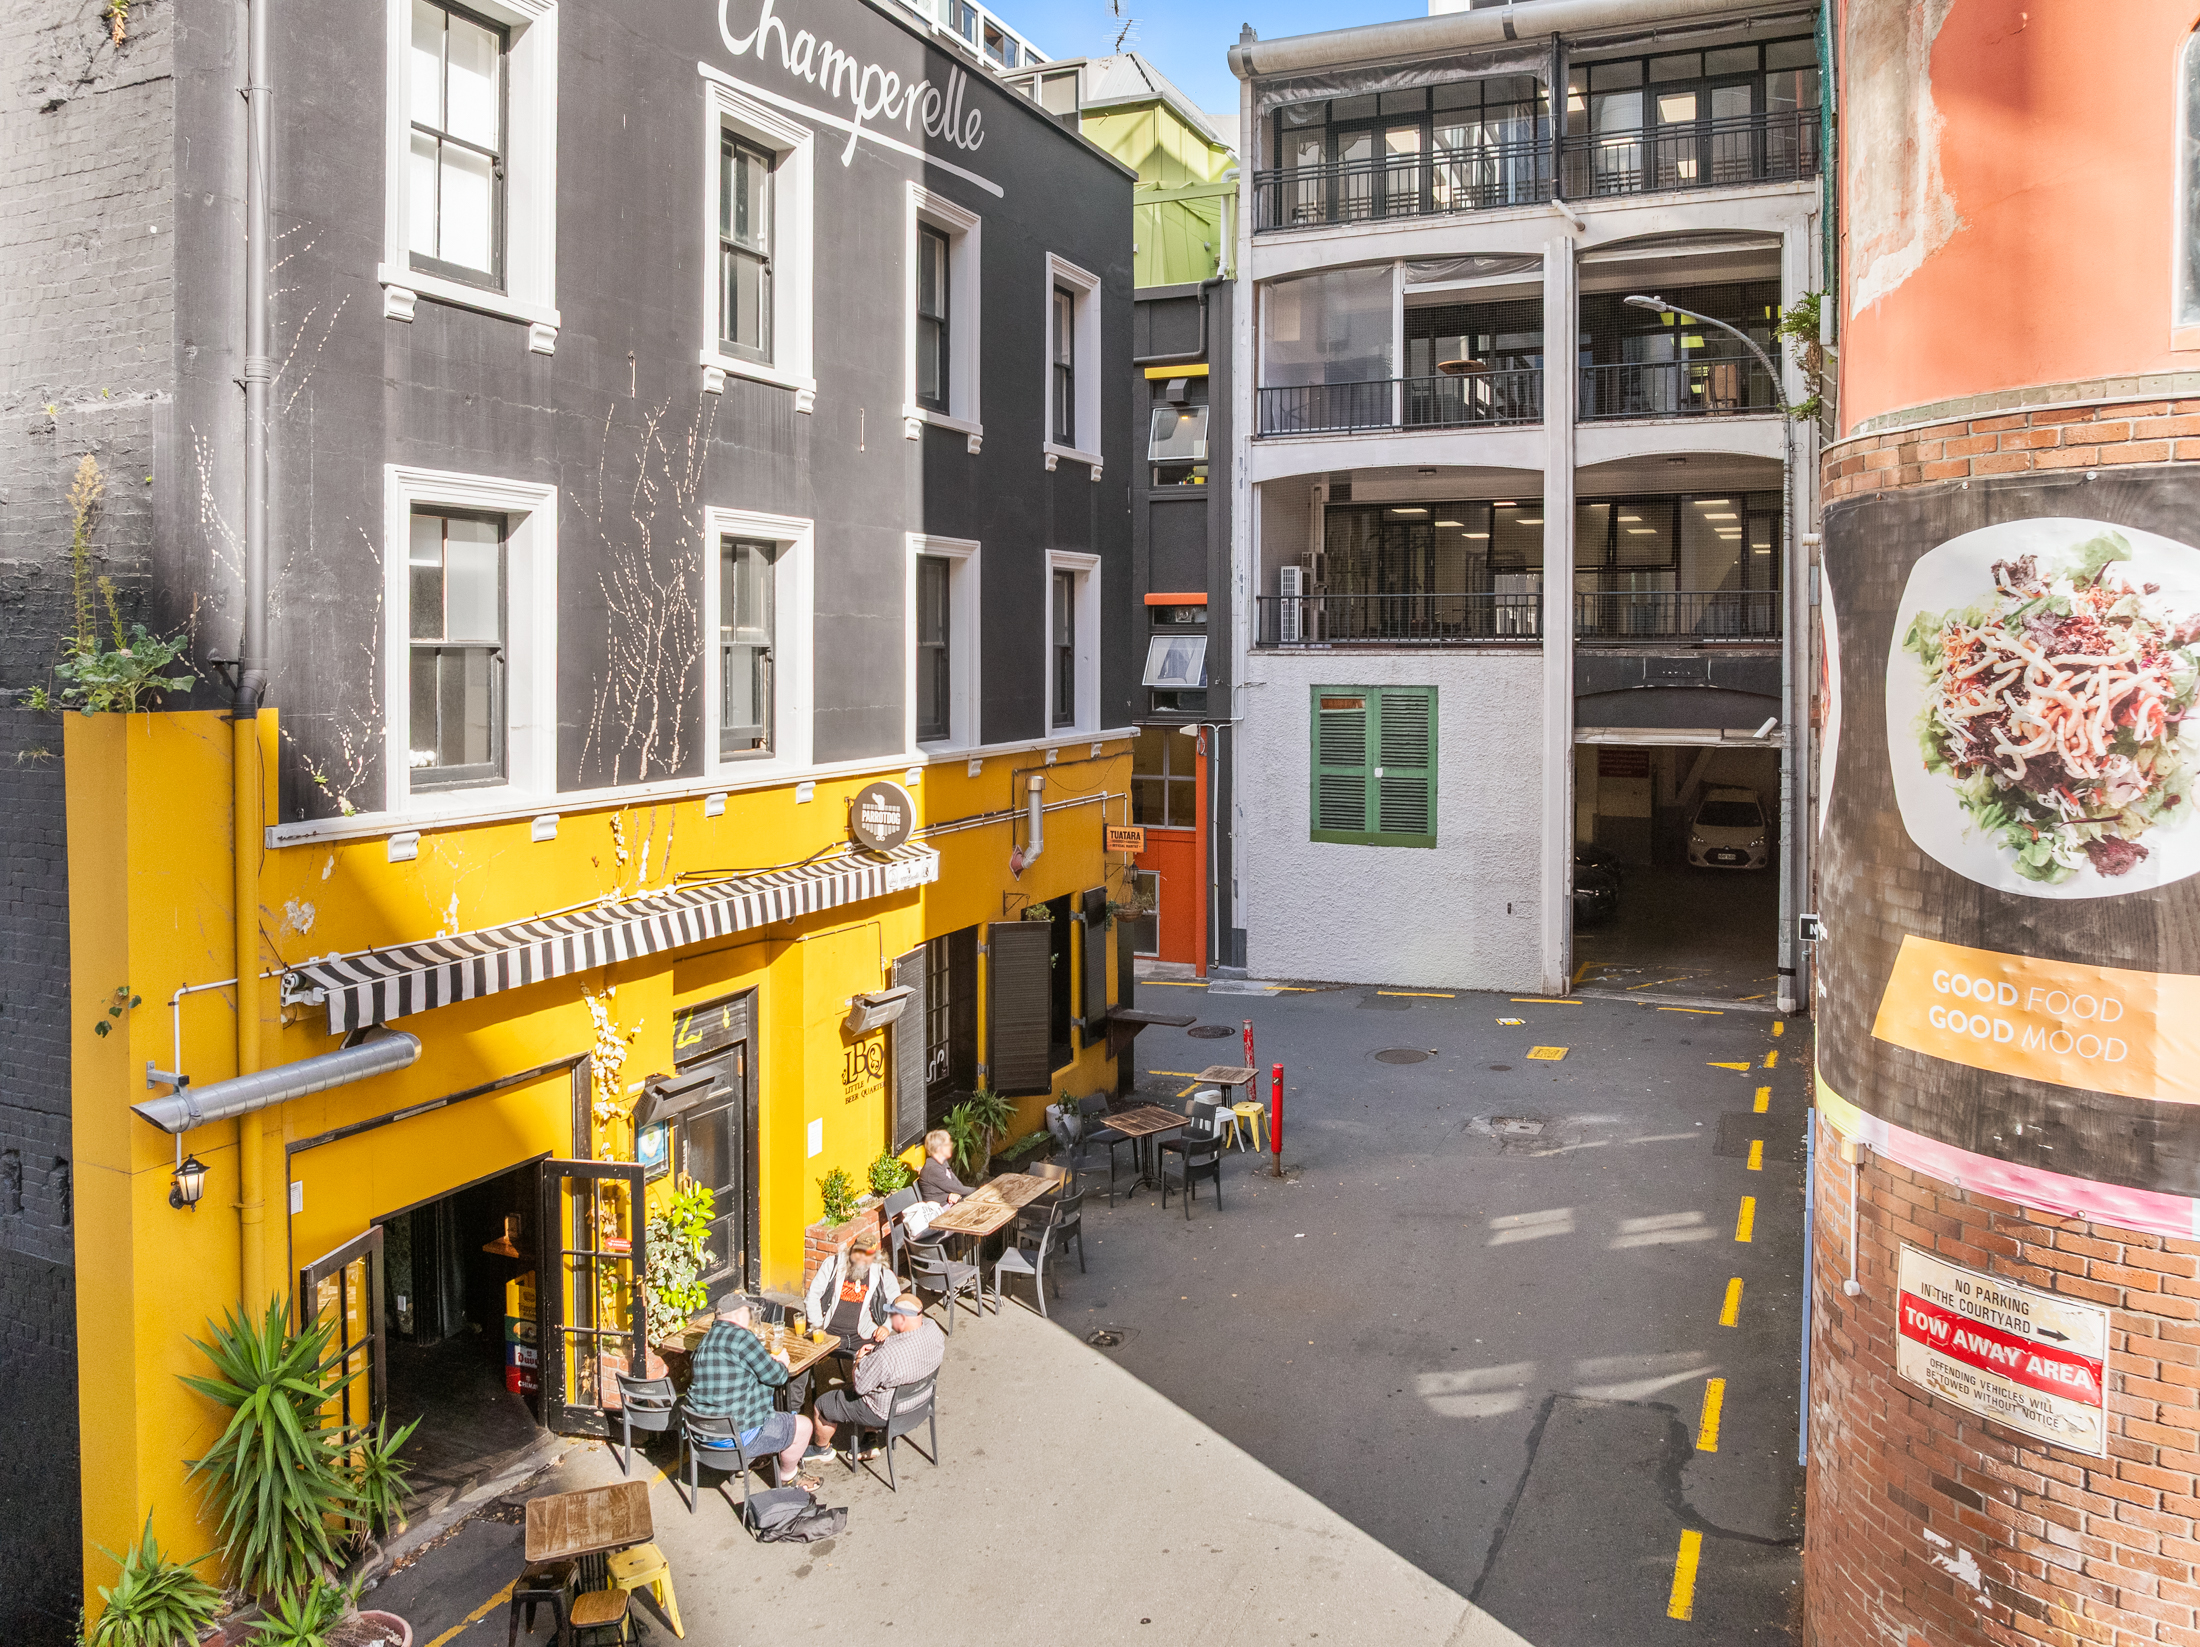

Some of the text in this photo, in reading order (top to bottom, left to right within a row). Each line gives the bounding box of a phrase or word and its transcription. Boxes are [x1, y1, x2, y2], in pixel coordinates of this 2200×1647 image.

[718, 0, 985, 167] Champerelle
[862, 810, 900, 825] PARROTDOG
[1110, 831, 1140, 840] TUATARA
[1932, 969, 2124, 1023] GOOD FOOD
[1929, 1005, 2127, 1062] GOOD MOOD
[845, 1081, 864, 1095] LITTLE
[845, 1093, 859, 1105] BEER
[1921, 1282, 2030, 1334] IN THE COURTYARD
[1955, 1279, 2029, 1315] NO PARKING
[1905, 1306, 2093, 1390] TOW AWAY AREA
[1926, 1368, 2059, 1427] BE TOWED WITHOUT NOTICE
[1930, 1358, 2053, 1414] OFFENDING VEHICLES WILL
